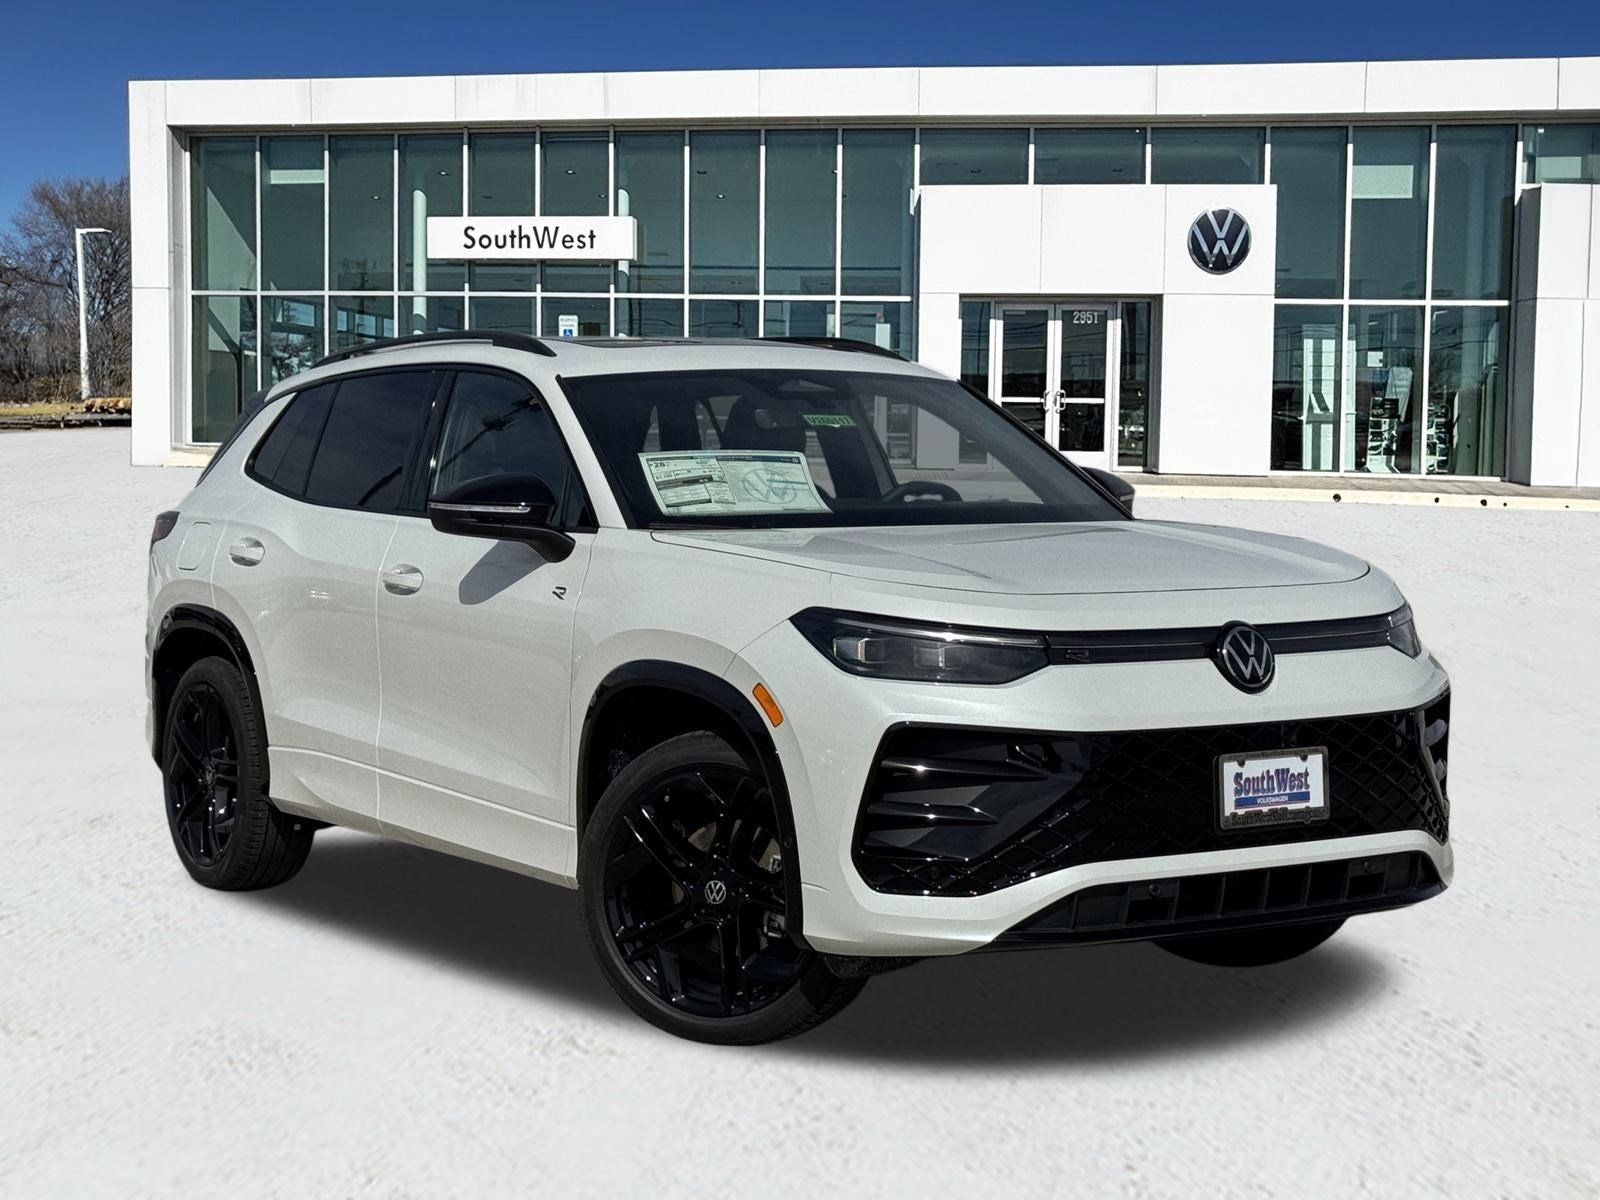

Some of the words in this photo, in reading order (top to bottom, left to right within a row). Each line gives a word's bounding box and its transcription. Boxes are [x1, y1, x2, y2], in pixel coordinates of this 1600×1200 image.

[463, 225, 596, 249] SouthWest
[1189, 207, 1250, 271] VW
[1073, 311, 1098, 324] 2951
[1223, 626, 1273, 687] VW
[1233, 767, 1310, 797] SouthWest
